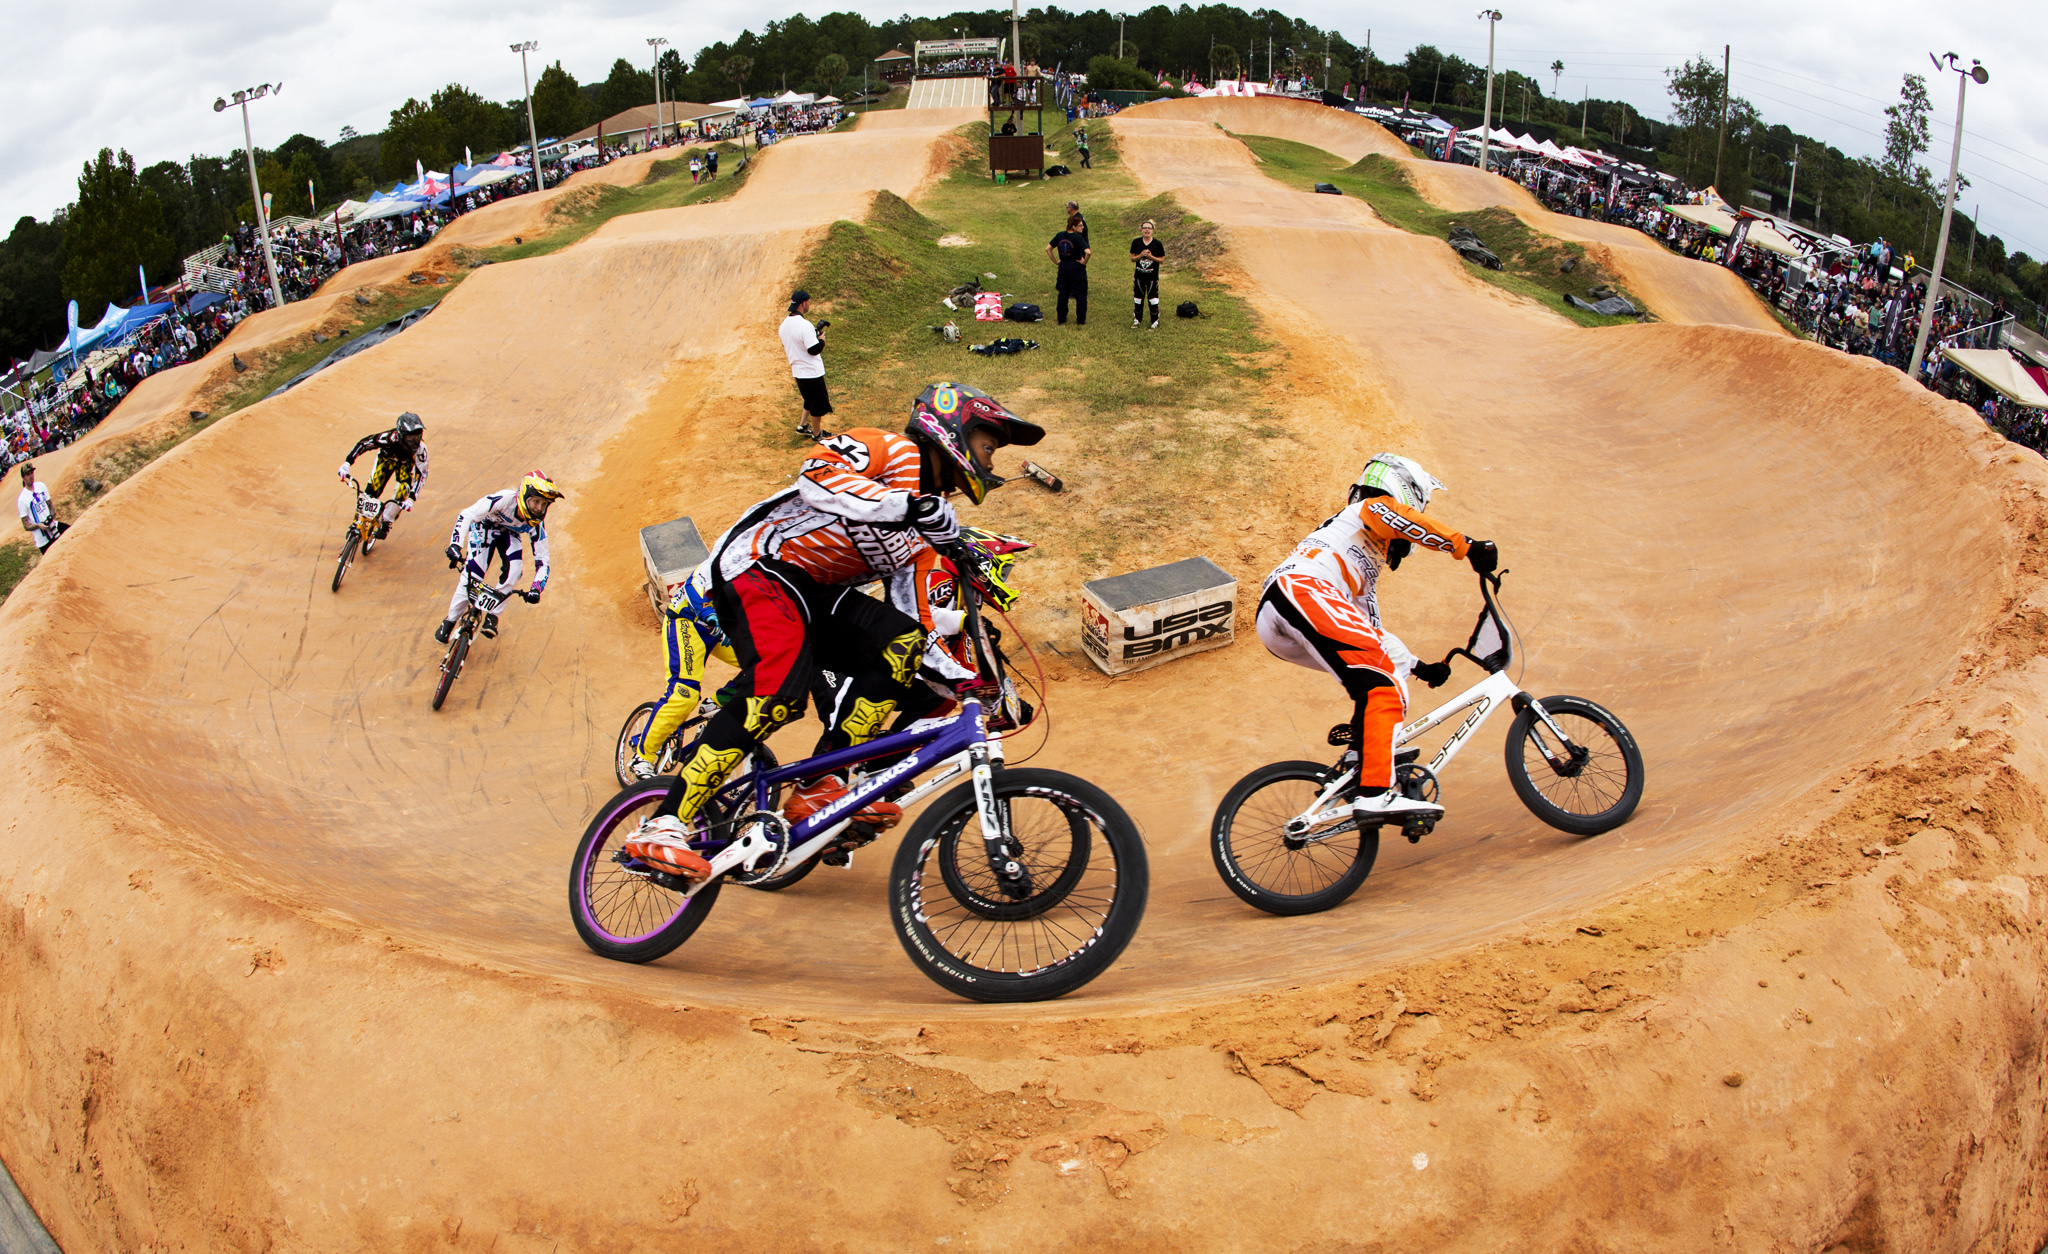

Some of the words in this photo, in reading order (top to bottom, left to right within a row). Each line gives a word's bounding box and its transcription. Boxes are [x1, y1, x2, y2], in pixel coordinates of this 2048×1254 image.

[364, 501, 378, 512] 882
[478, 594, 496, 611] 310
[680, 619, 689, 634] Troy
[1123, 600, 1233, 641] USA
[1123, 616, 1231, 660] BMX
[1123, 658, 1136, 666] THE
[1430, 696, 1491, 770] SPEED
[808, 754, 919, 828] DOUBLECROSS
[968, 896, 996, 909] KENDA
[937, 961, 964, 980] TIOGA
